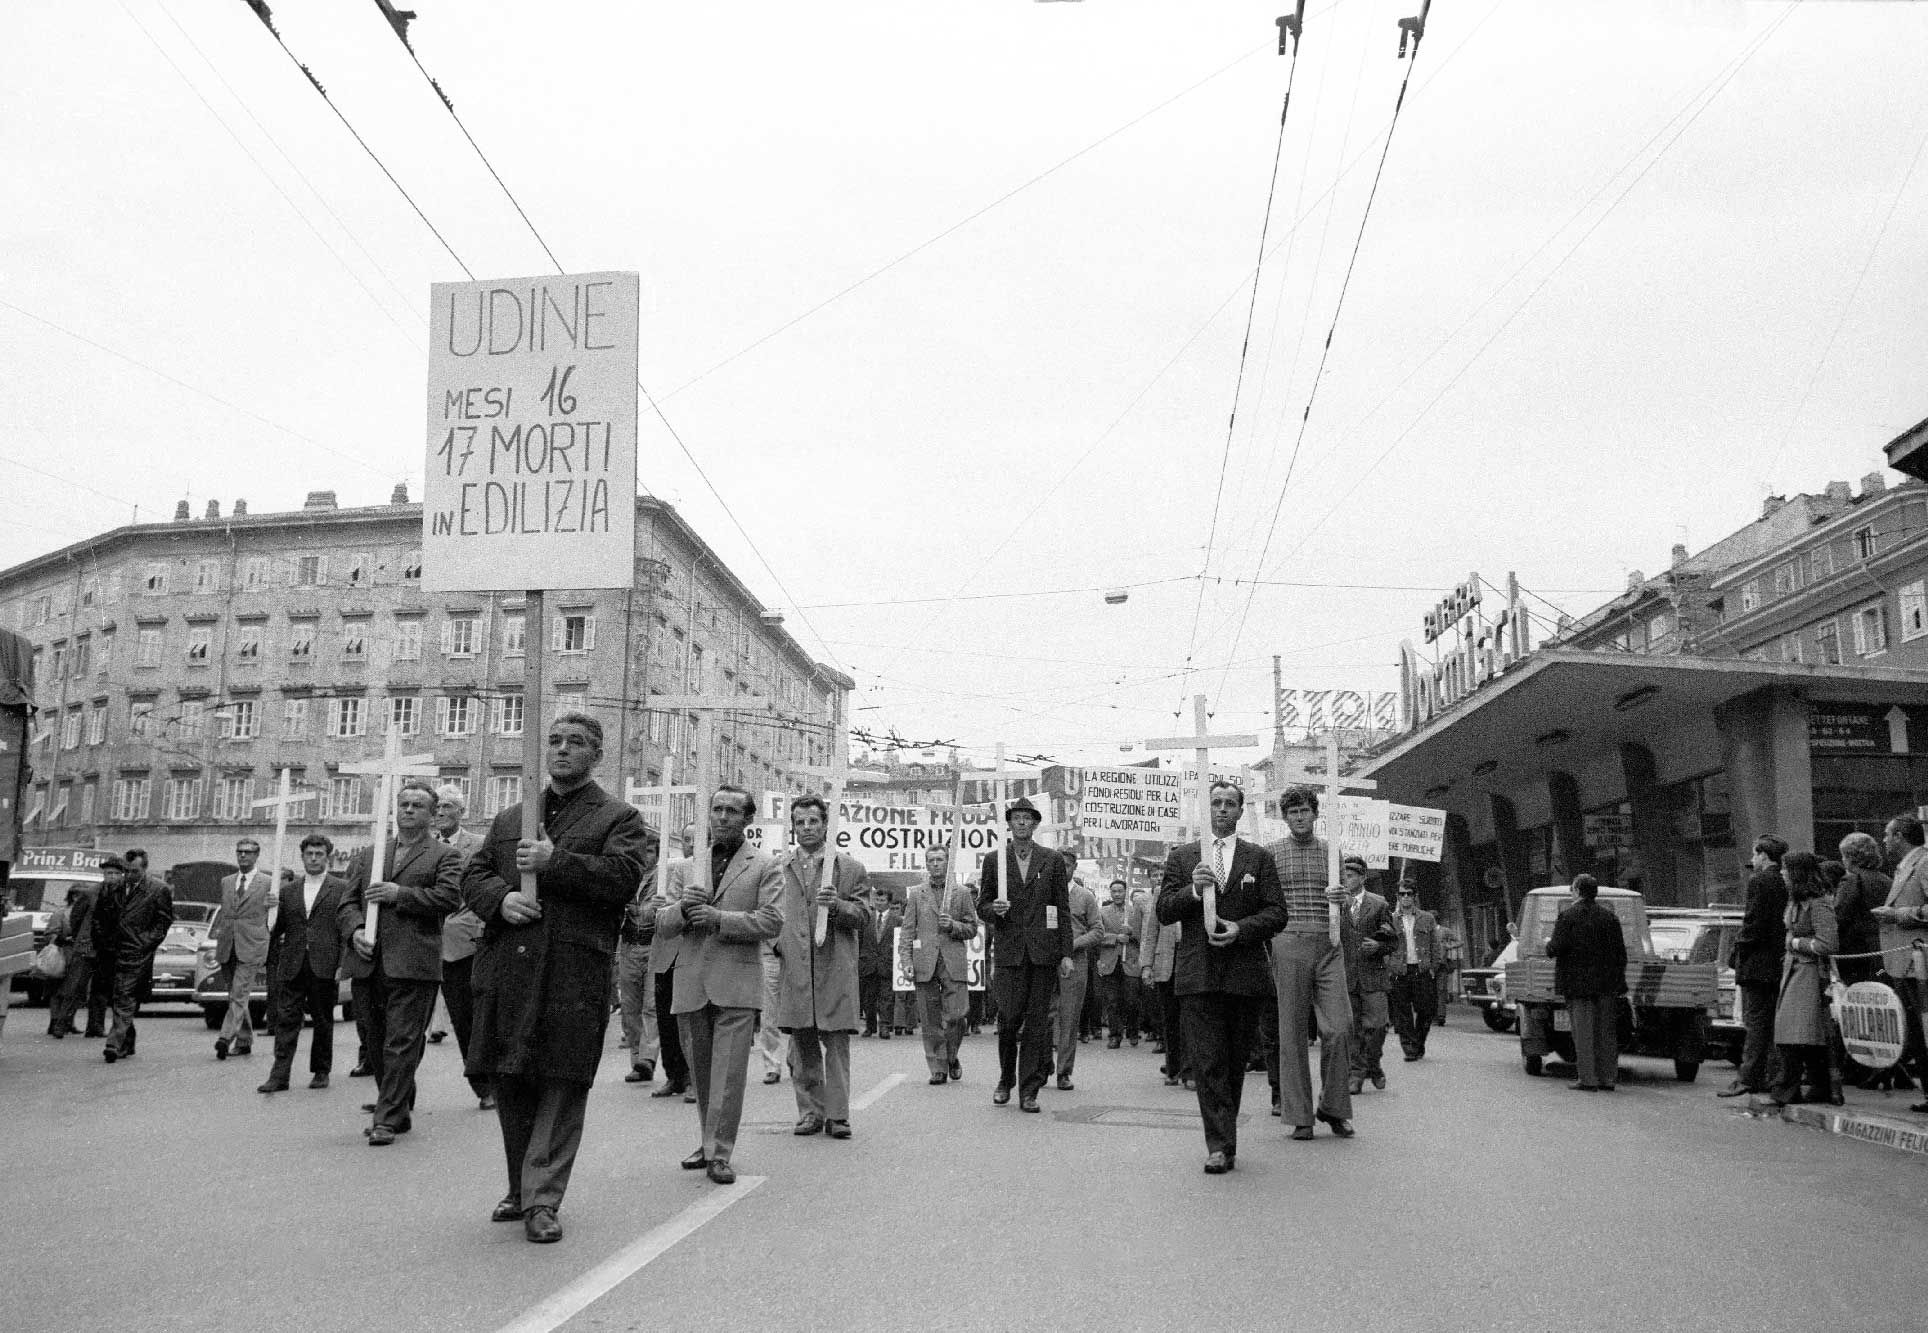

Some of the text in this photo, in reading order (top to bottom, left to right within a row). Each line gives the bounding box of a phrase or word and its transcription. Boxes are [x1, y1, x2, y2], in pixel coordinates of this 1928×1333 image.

[450, 281, 615, 356] UDINE
[444, 365, 577, 419] MESI 16
[437, 422, 611, 475] 17 MORTI
[432, 479, 609, 536] IN EDILIZIA
[1085, 771, 1098, 782] LA
[1100, 772, 1137, 784] REGIONE
[1147, 790, 1162, 801] PER
[1165, 792, 1178, 803] LA
[1085, 802, 1145, 816] COSTRUZIONE
[1147, 807, 1155, 817] DI
[1158, 807, 1179, 819] CASE
[1083, 817, 1097, 828] PER
[22, 850, 106, 868] Prinz Brä
[1842, 1119, 1897, 1146] MAGAZZINI
